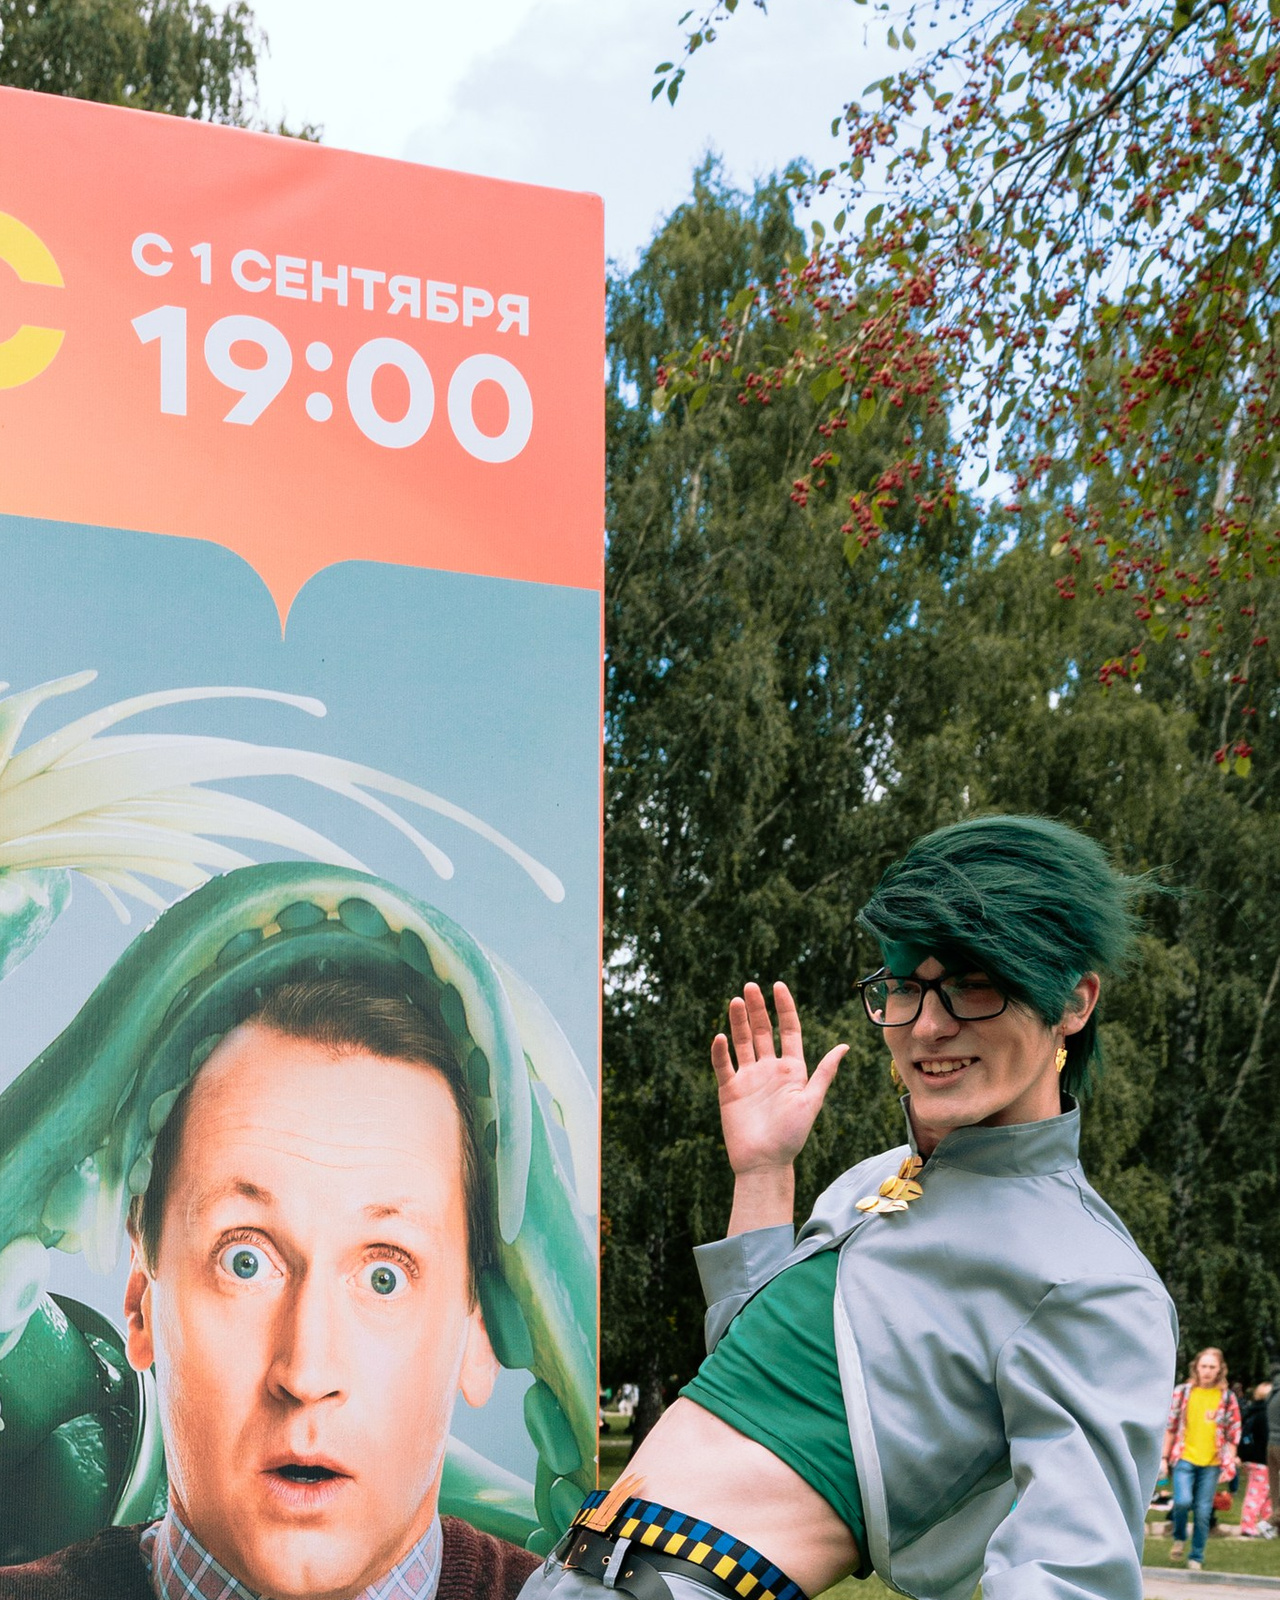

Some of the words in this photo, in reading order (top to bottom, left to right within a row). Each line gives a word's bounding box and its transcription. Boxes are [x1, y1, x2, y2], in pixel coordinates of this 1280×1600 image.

[131, 232, 174, 277] С
[189, 241, 212, 285] 1
[230, 248, 530, 337] СЕНТЯБРЯ
[130, 304, 534, 464] 19:00
